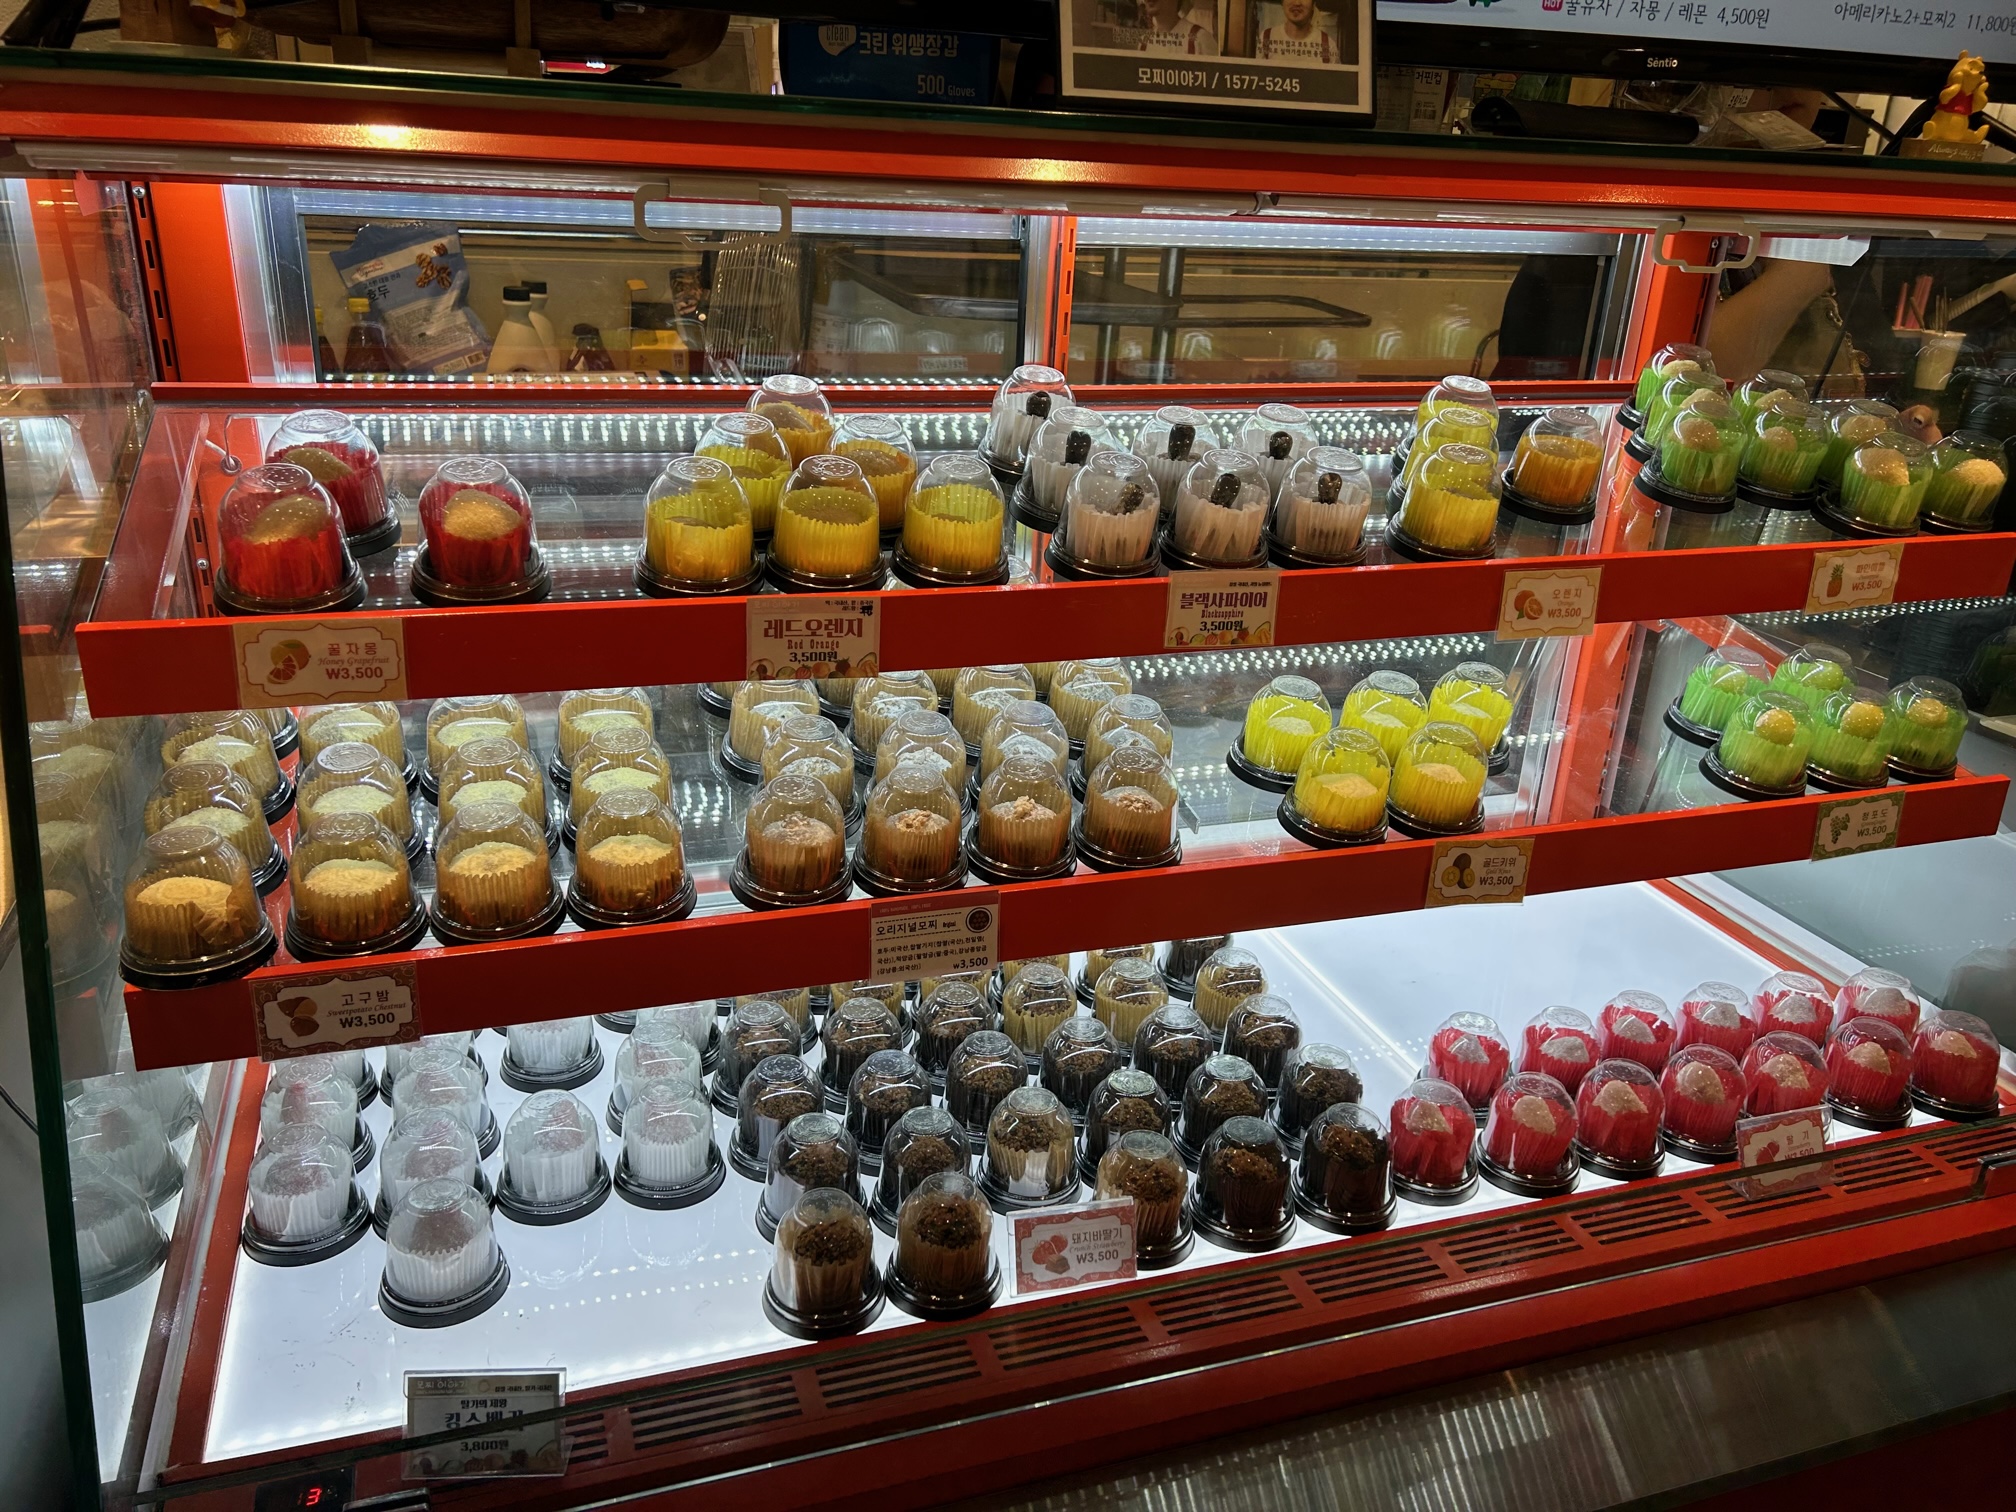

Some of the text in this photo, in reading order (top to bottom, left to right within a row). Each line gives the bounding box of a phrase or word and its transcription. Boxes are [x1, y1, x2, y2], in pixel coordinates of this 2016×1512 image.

[1629, 1, 1661, 21] 자몽
[1678, 4, 1708, 25] 레몬
[1717, 7, 1770, 29] 4,500원
[1834, 2, 1956, 28] 아메리카노2+모찌2
[859, 32, 959, 58] 크린 위생장갑
[917, 75, 975, 97] 500 Gloves
[1138, 67, 1207, 88] 모찌이야기
[1224, 74, 1300, 93] 1577-5245
[366, 284, 390, 301] 호두
[1180, 592, 1268, 609] 블랙사파이어
[1552, 588, 1582, 599] 오렌지
[1201, 609, 1244, 620] Blacksapphire
[763, 618, 863, 639] 레드오렌지
[1200, 620, 1244, 633] 3,500원
[787, 639, 840, 651] Red Orange
[317, 656, 390, 667] Honey Grapefruit
[789, 651, 838, 664] 3,500원
[1483, 857, 1517, 868] 골드키위
[875, 919, 938, 936] 오리지널모찌
[342, 989, 390, 1007] 고구밤
[326, 1002, 407, 1018] Sweetpotato Chestnut
[1072, 1228, 1123, 1245] 돼지바딸기
[1069, 1240, 1127, 1254] Crunch Strawberry
[460, 1398, 508, 1409] 딸기의 제왕
[460, 1440, 509, 1453] 3,800원
